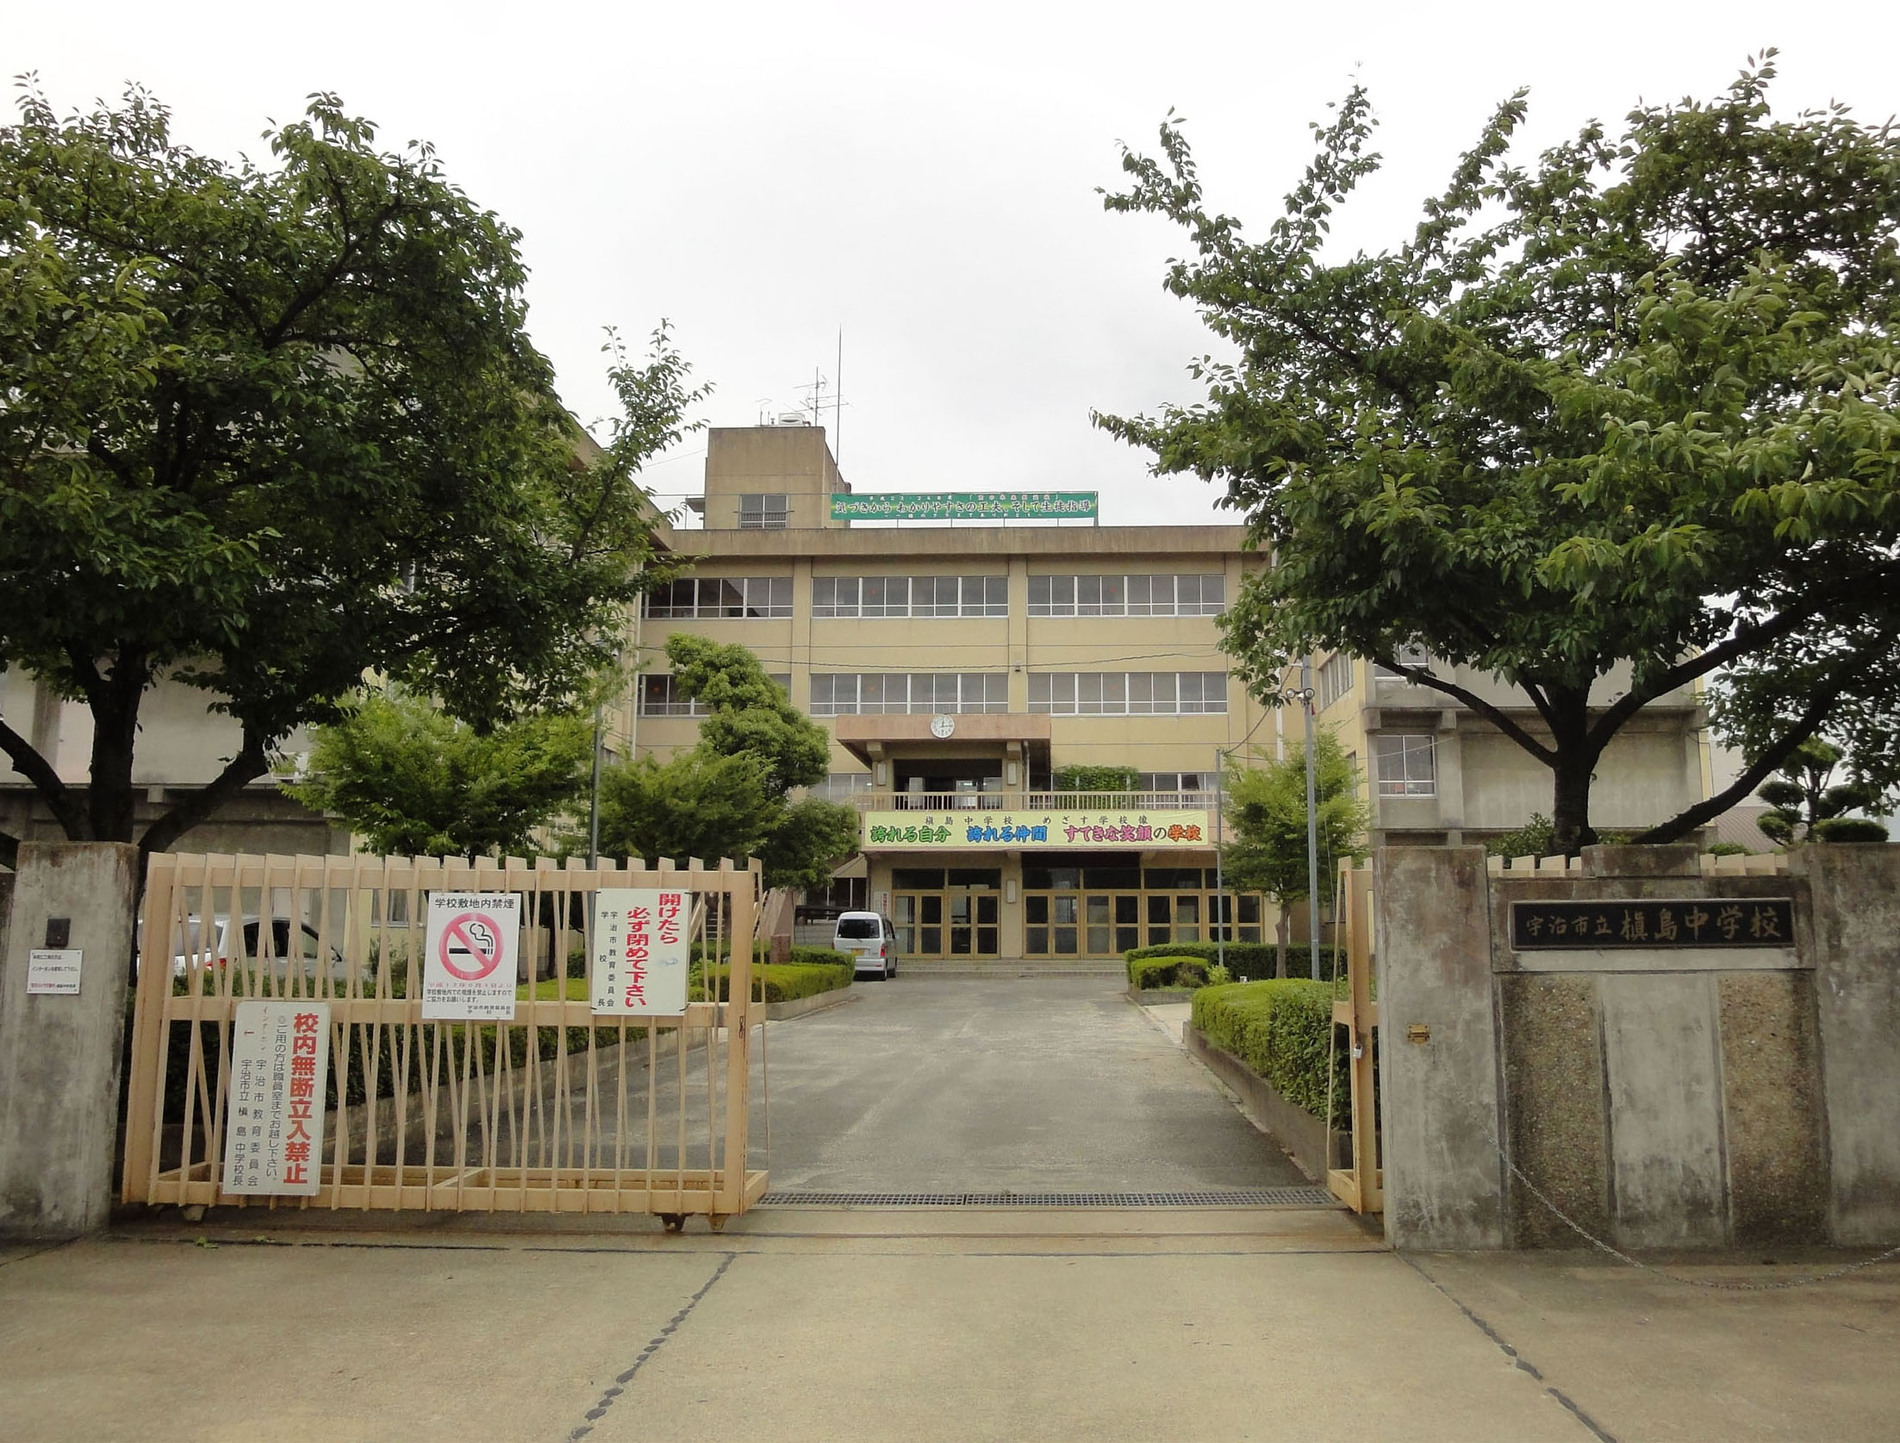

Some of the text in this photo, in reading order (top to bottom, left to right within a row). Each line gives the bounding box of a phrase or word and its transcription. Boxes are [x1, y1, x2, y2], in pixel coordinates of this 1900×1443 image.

[870, 824, 1202, 843] 誇れる自分 誇れる仲間 すてきな笑顔の学校
[1043, 815, 1148, 825] めざす学校像
[435, 897, 515, 909] 学校敷地内禁煙
[657, 893, 682, 944] 開けたら
[606, 911, 618, 1007] 宇治市教育委員会
[624, 906, 651, 1008] 必ず閉めて下さい
[247, 1059, 266, 1187] 宇治市教育委員会
[283, 1012, 319, 1184] 校内無断立入禁止
